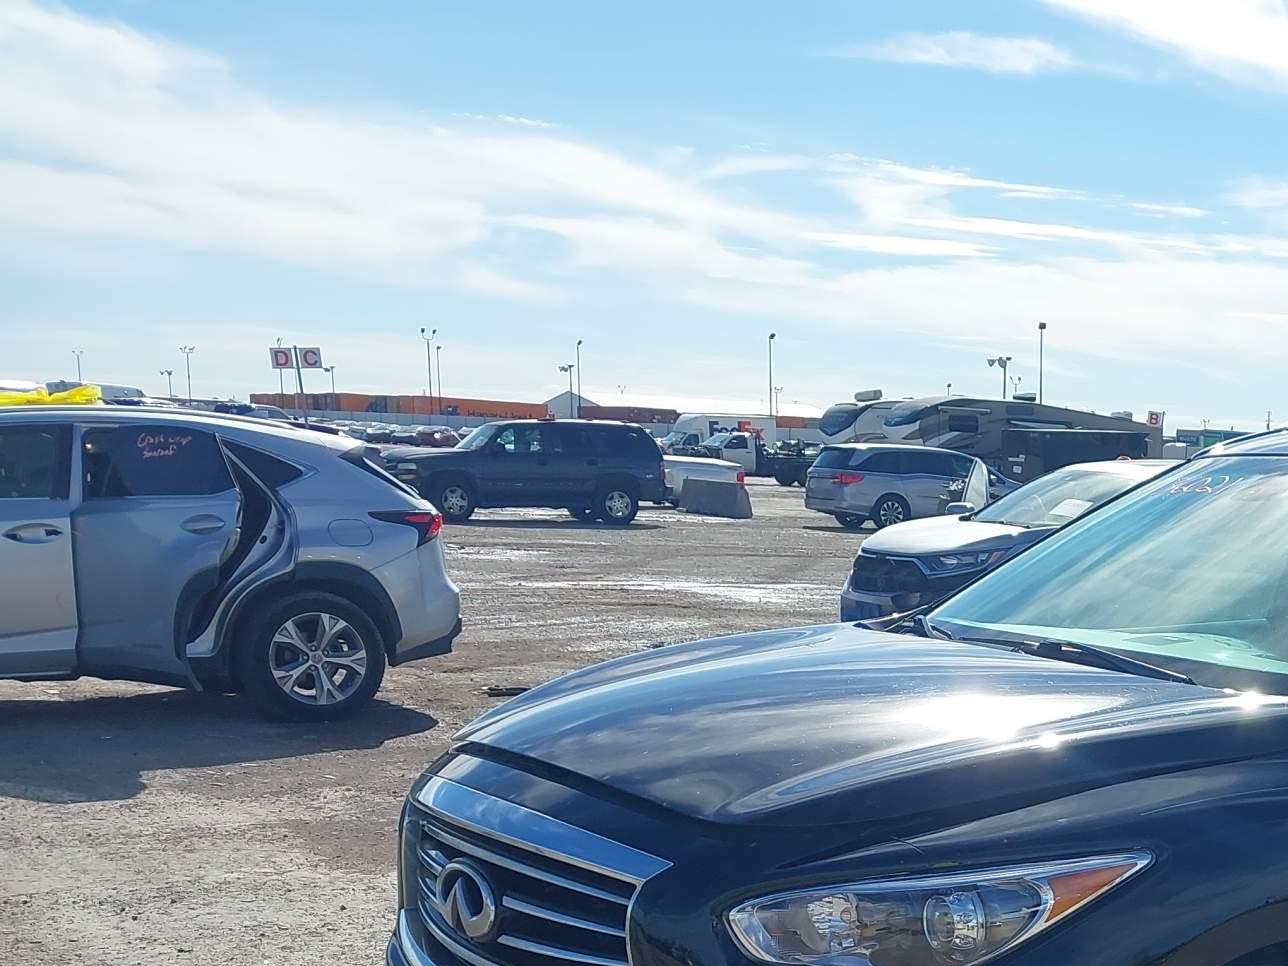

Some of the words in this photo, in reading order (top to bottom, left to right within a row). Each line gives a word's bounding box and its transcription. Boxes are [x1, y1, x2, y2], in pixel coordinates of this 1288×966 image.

[273, 350, 289, 366] D
[303, 350, 318, 366] C
[1149, 413, 1159, 425] B
